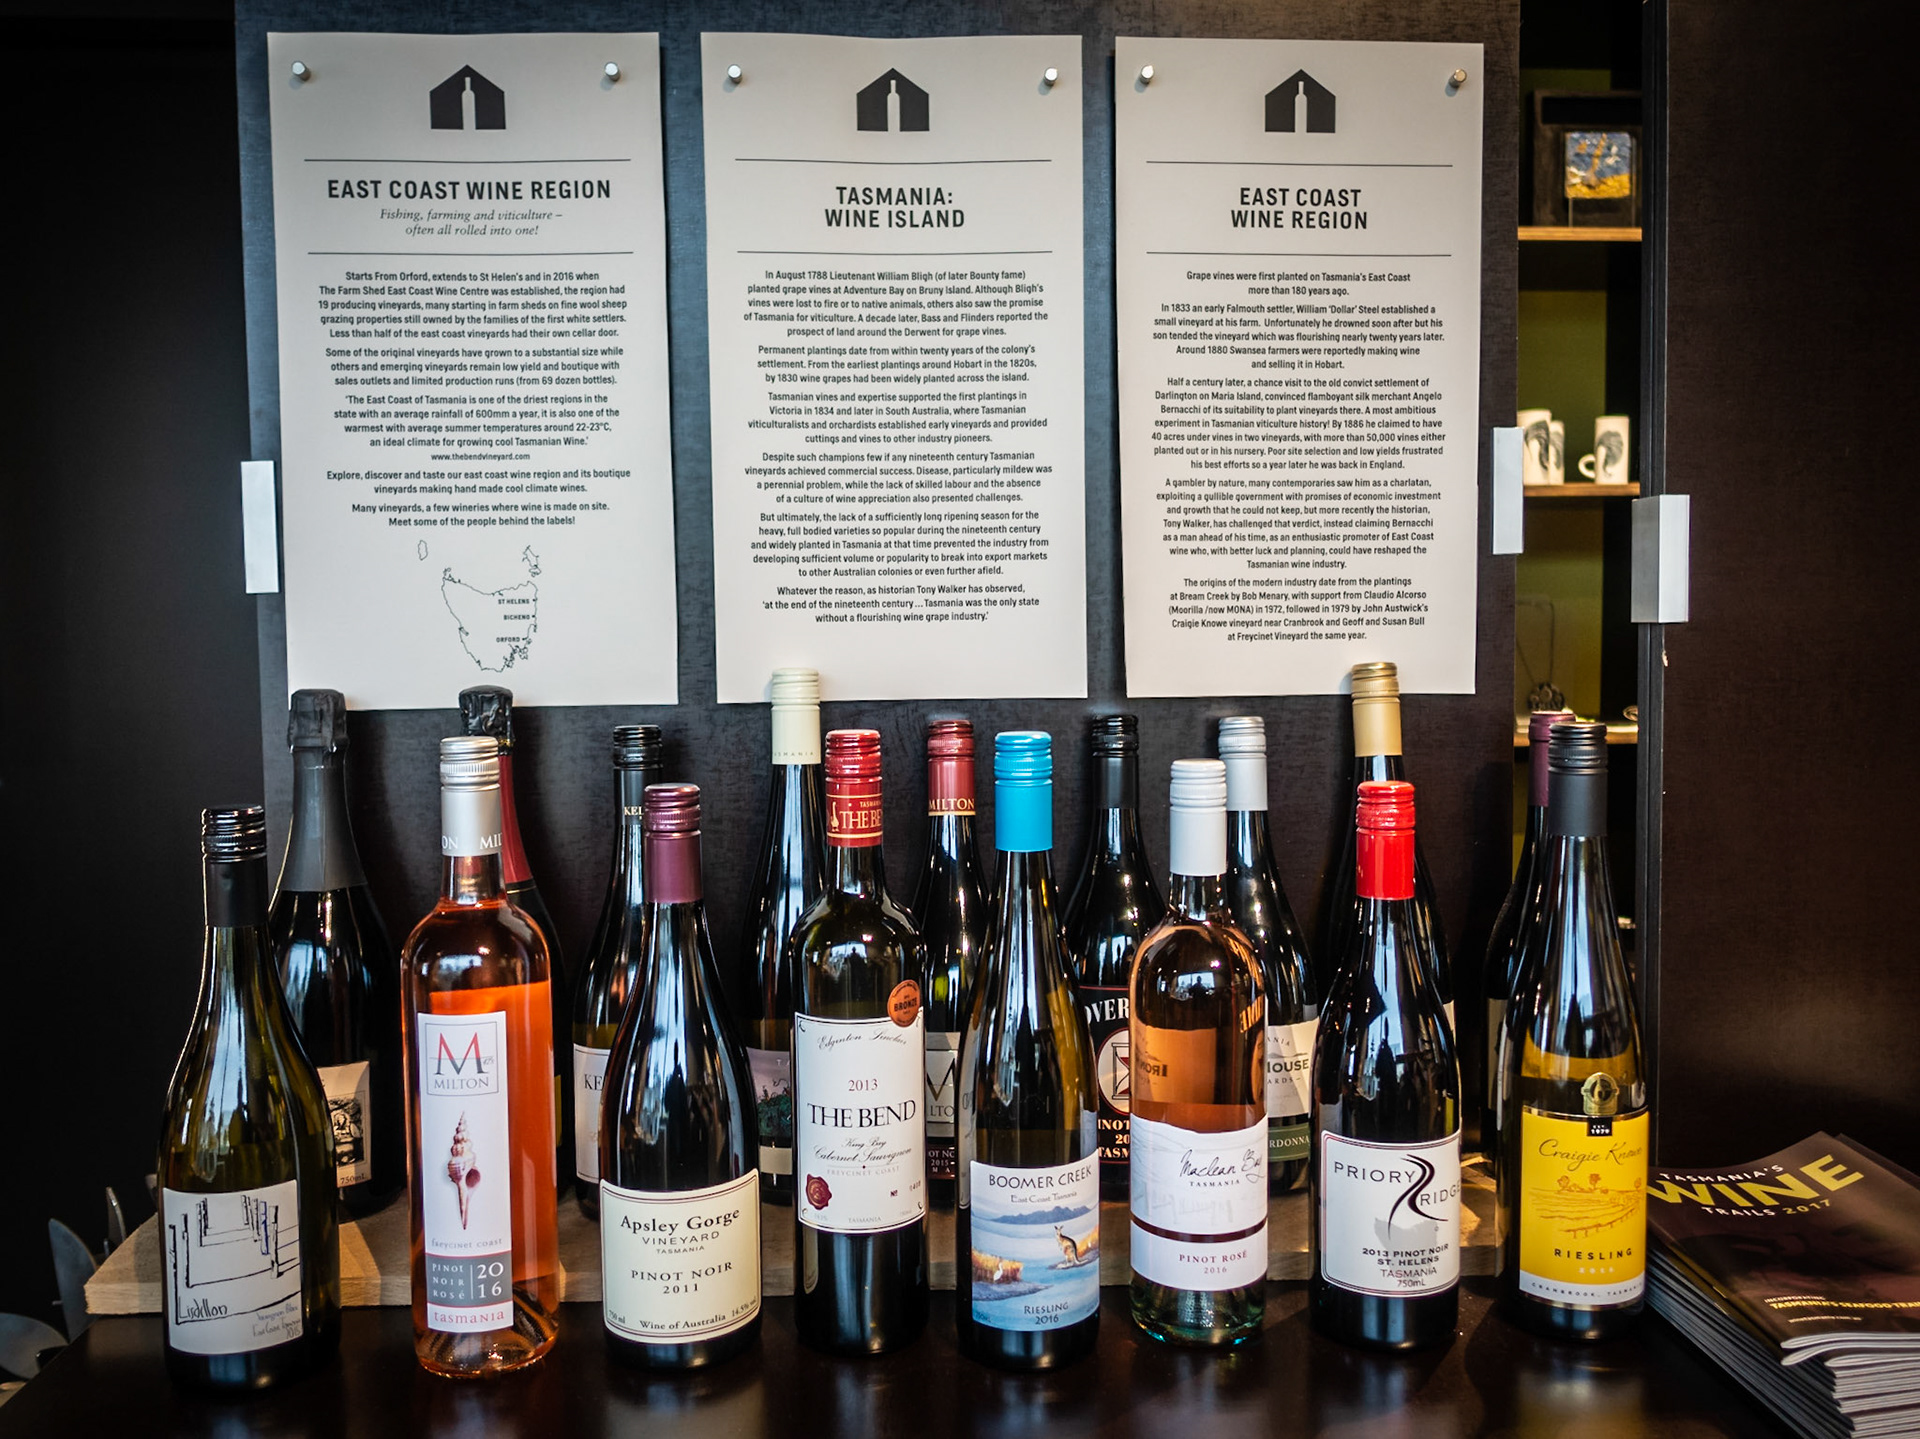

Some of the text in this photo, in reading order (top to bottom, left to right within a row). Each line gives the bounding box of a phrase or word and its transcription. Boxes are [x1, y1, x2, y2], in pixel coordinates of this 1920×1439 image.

[327, 179, 610, 200] EAST COAST WINE REGION
[835, 186, 952, 206] TASMANIA:
[1240, 187, 1362, 207] EAST COAST
[379, 208, 553, 223] Fishing, farming and viticulture
[824, 208, 964, 228] WINE ISLAND
[1231, 209, 1367, 230] WINE REGION
[405, 223, 539, 237] often all rolled into one!
[345, 271, 599, 282] Starts From Orford, extends to St Helen's and in 2016 when
[765, 270, 1026, 282] In August 1788 Lieutenant William Bligh (of later Bounty fame)
[1176, 345, 1206, 354] Around
[1207, 345, 1228, 354] 1880
[1229, 345, 1266, 355] Swansea
[1268, 346, 1300, 355] farmers
[1323, 346, 1366, 357] reportedly
[1367, 346, 1398, 357] making
[1399, 346, 1420, 355] wine
[430, 453, 530, 462] www.thebendvineyard.com
[388, 517, 412, 526] Meet
[439, 517, 449, 526] of
[450, 517, 465, 526] the
[467, 517, 497, 528] people
[498, 516, 529, 526] behind
[530, 516, 545, 525] the
[547, 516, 575, 525] labels!
[815, 613, 848, 623] without
[856, 613, 902, 623] flourishing
[903, 612, 924, 621] wine
[925, 613, 950, 623] grape
[951, 611, 989, 622] industry.'
[1227, 631, 1367, 642] at Freycinet Vineyard the same year.
[928, 798, 974, 810] MILTON
[840, 811, 869, 829] THE
[894, 997, 917, 1012] BRONZE
[433, 1032, 490, 1076] M
[434, 1077, 489, 1090] MILTON
[848, 1078, 878, 1092] 2013
[807, 1102, 853, 1128] THE
[859, 1100, 916, 1128] BEND
[813, 1145, 858, 1163] Cabernet
[1538, 1139, 1601, 1171] Craigie
[1179, 1149, 1236, 1177] Maclean
[989, 1165, 1092, 1189] BOOMER CREEK
[1334, 1161, 1416, 1183] PRIORY
[1659, 1163, 1783, 1182] TASMANIA'S
[1190, 1179, 1240, 1187] TASMANIA
[1648, 1154, 1864, 1207] WINE
[1011, 1191, 1077, 1203] East Coast Tasmania
[1702, 1198, 1831, 1216] TRAILS 2017
[620, 1209, 740, 1236] Apsley Gorge
[477, 1238, 502, 1248] coast
[642, 1231, 720, 1245] VINEYARD
[656, 1246, 705, 1254] TASMANIA
[1179, 1250, 1248, 1263] PINOT ROSÉ
[1362, 1243, 1449, 1257] 2013 PINOT NOIR
[1554, 1248, 1633, 1260] RIESLING
[1377, 1256, 1439, 1266] ST. HELENS
[477, 1262, 504, 1279] 20
[631, 1262, 732, 1281] PINOT NOIR
[1380, 1267, 1437, 1278] TASMANIA
[432, 1277, 464, 1286] NOIR
[663, 1283, 699, 1294] 2011
[1397, 1279, 1426, 1287] 750mL
[479, 1280, 502, 1299] 16
[1024, 1302, 1069, 1314] RIESLING
[1770, 1300, 1839, 1310] TASMANIA'S
[640, 1303, 749, 1330] Wine of Australia 14.5%
[1035, 1314, 1059, 1325] 2016
